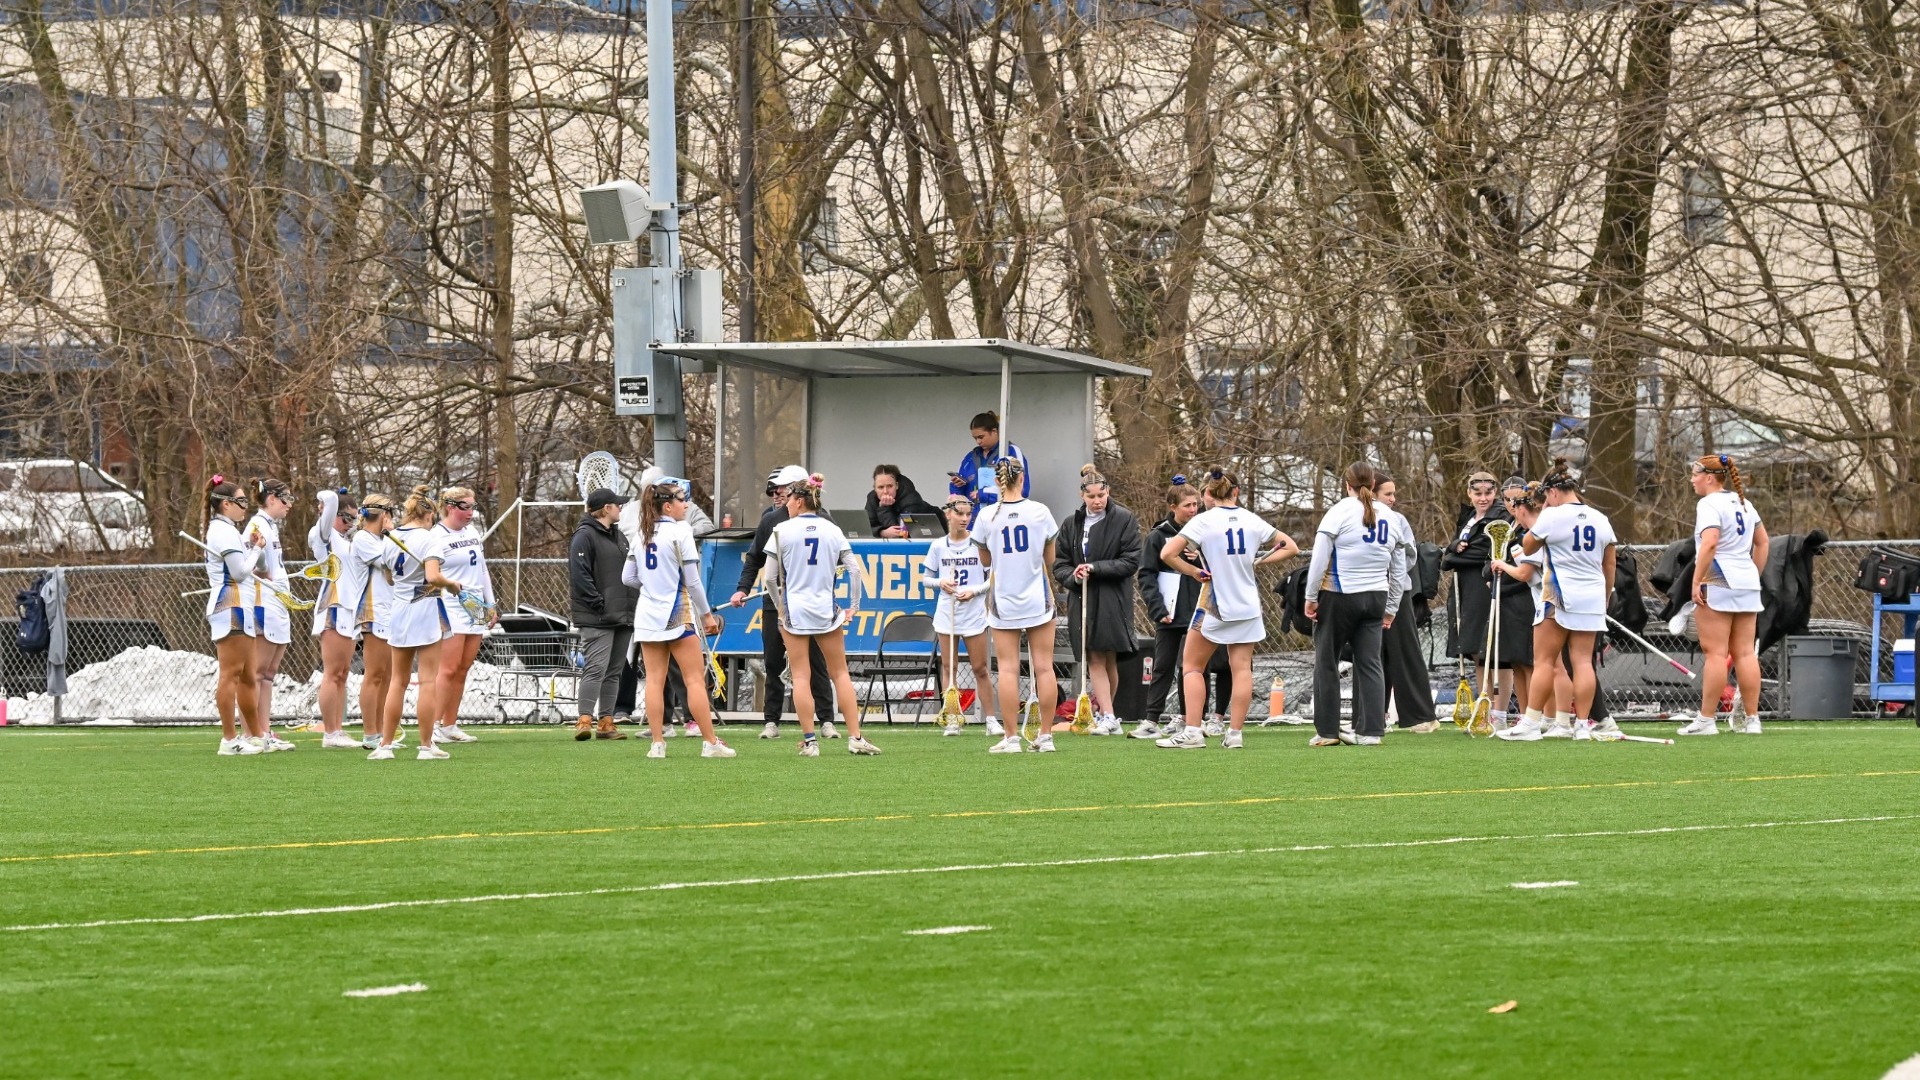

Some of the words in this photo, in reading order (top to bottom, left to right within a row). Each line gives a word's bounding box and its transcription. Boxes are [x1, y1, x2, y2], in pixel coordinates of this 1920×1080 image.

[1363, 519, 1388, 544] 30
[1735, 511, 1745, 535] 9
[804, 538, 819, 565] 7
[1001, 525, 1029, 553] 10
[1225, 528, 1246, 555] 11
[1572, 525, 1595, 551] 19
[394, 539, 405, 576] 4
[468, 549, 477, 566] 2
[645, 543, 657, 570] 6
